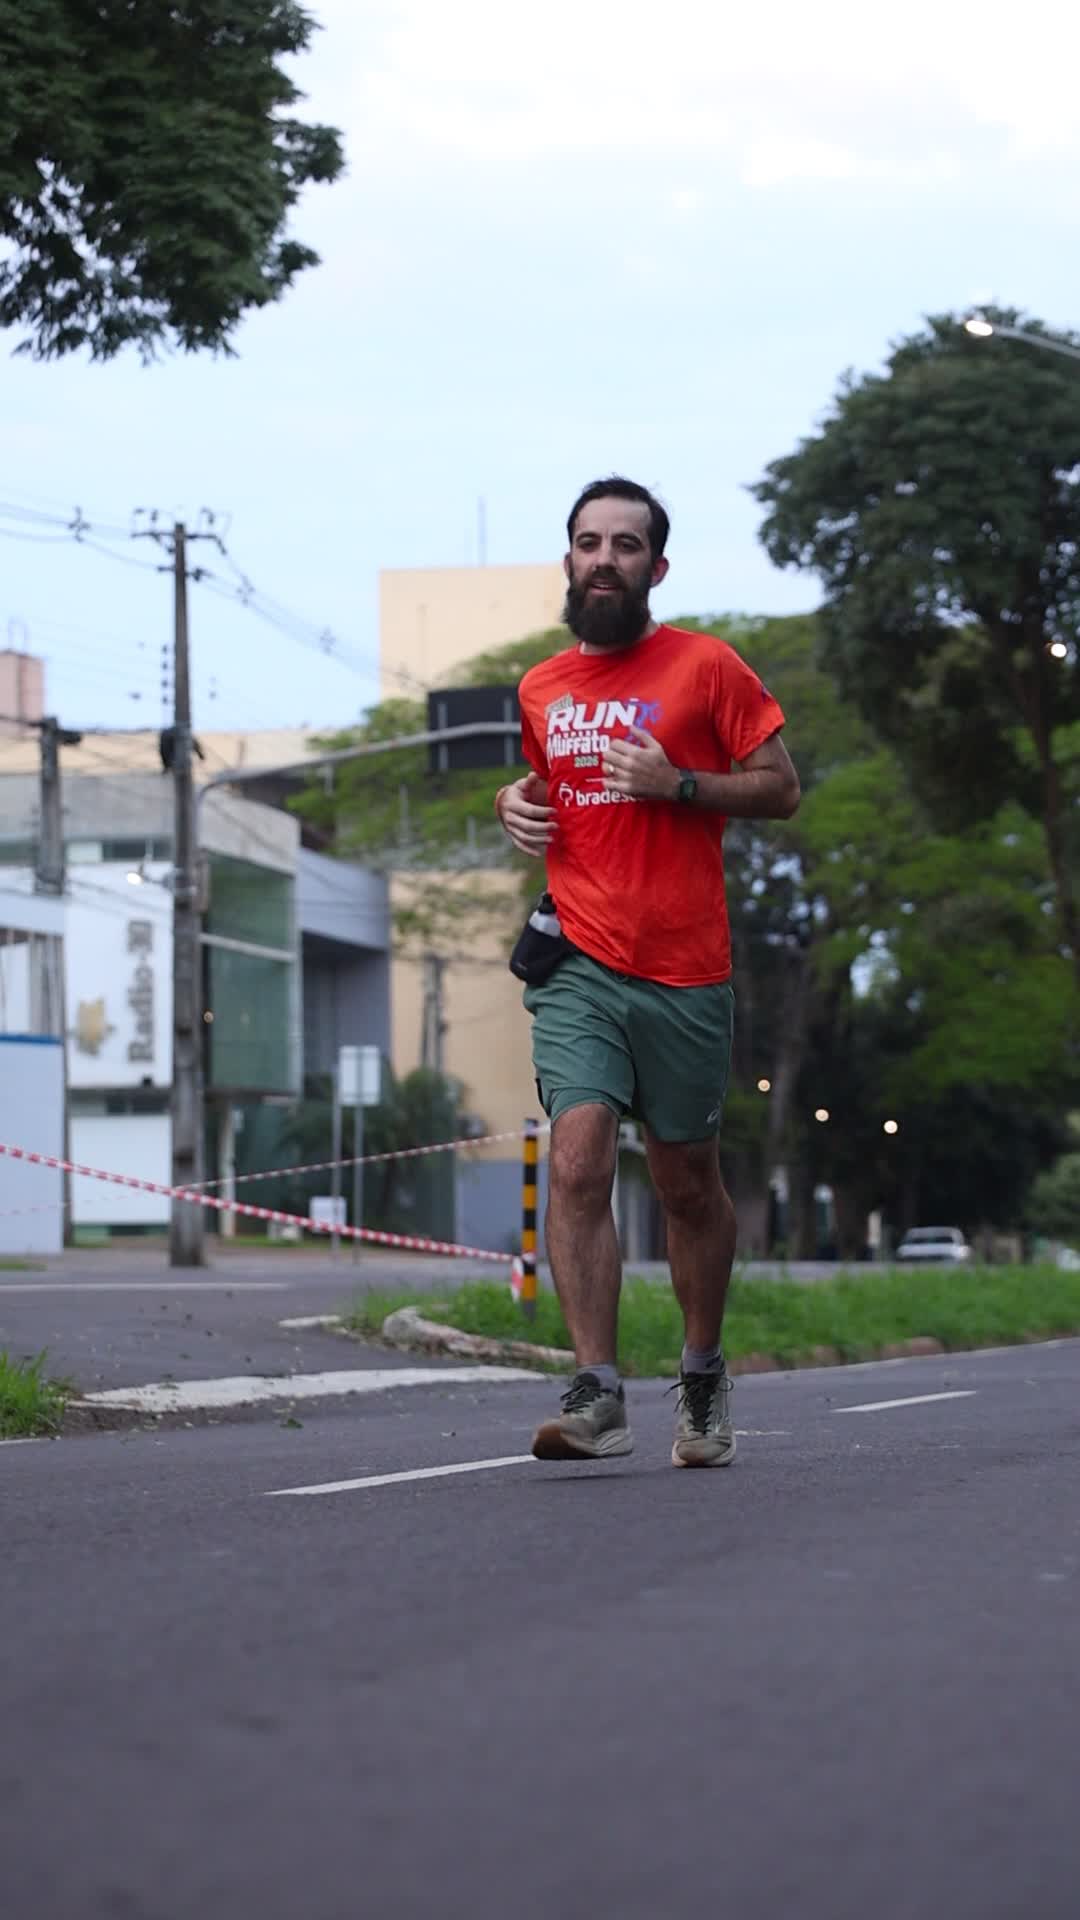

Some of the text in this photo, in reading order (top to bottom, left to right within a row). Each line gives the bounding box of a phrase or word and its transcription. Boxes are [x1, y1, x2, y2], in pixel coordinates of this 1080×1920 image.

[547, 701, 637, 734] RUN
[546, 734, 610, 759] Muffato
[575, 788, 645, 806] brades
